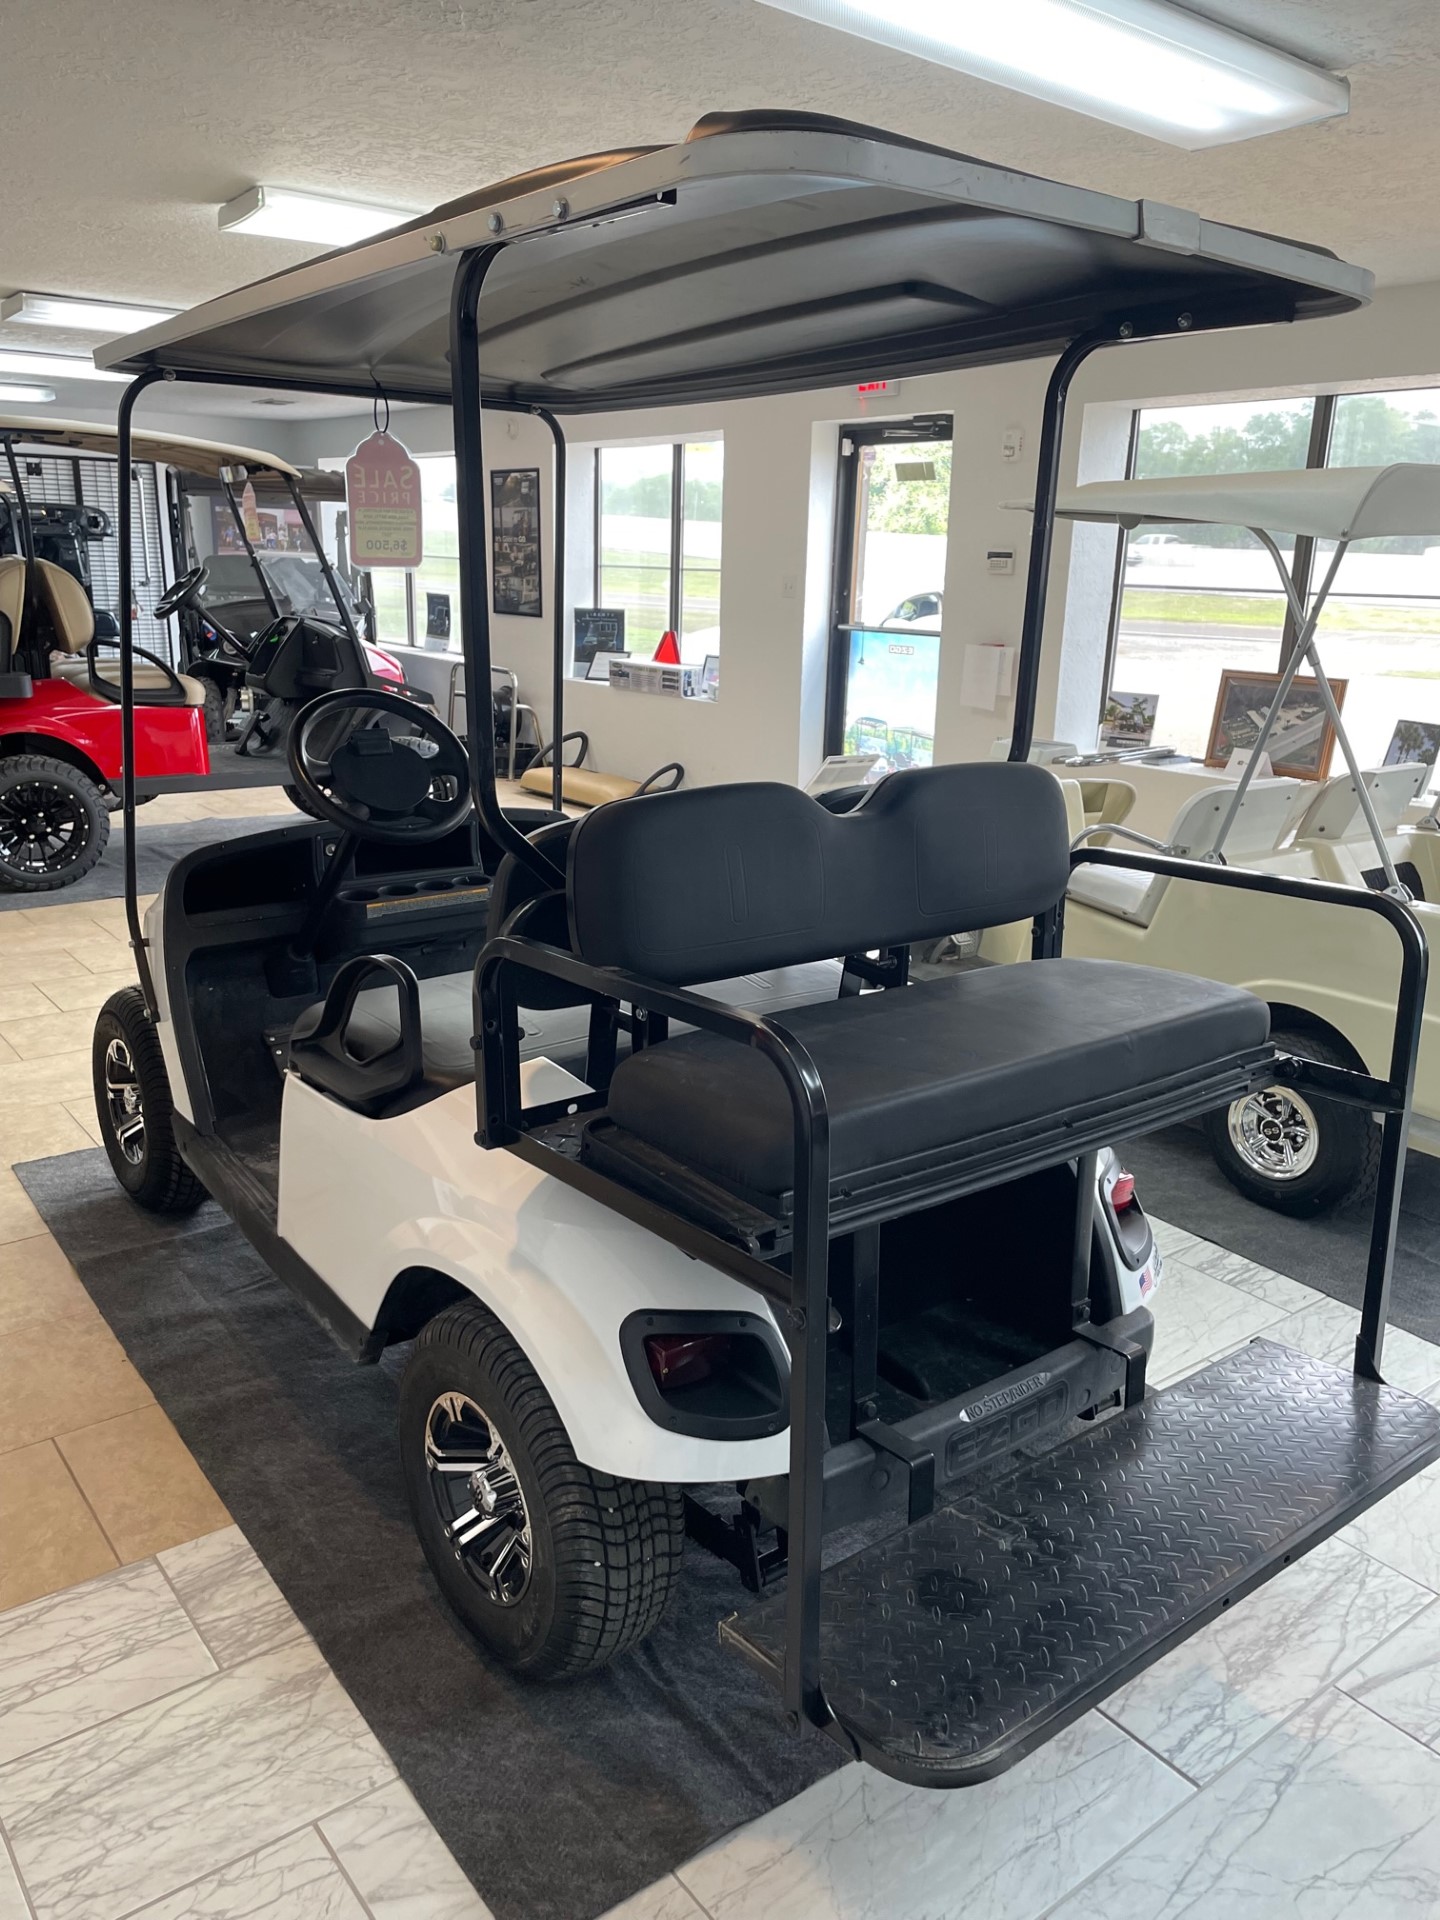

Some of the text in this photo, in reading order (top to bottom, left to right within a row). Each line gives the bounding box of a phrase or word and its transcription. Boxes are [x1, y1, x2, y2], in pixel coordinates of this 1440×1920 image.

[1264, 1127, 1279, 1136] SS
[965, 1376, 1044, 1420] NO STEP/RIDER
[950, 1387, 1064, 1471] EZGO
